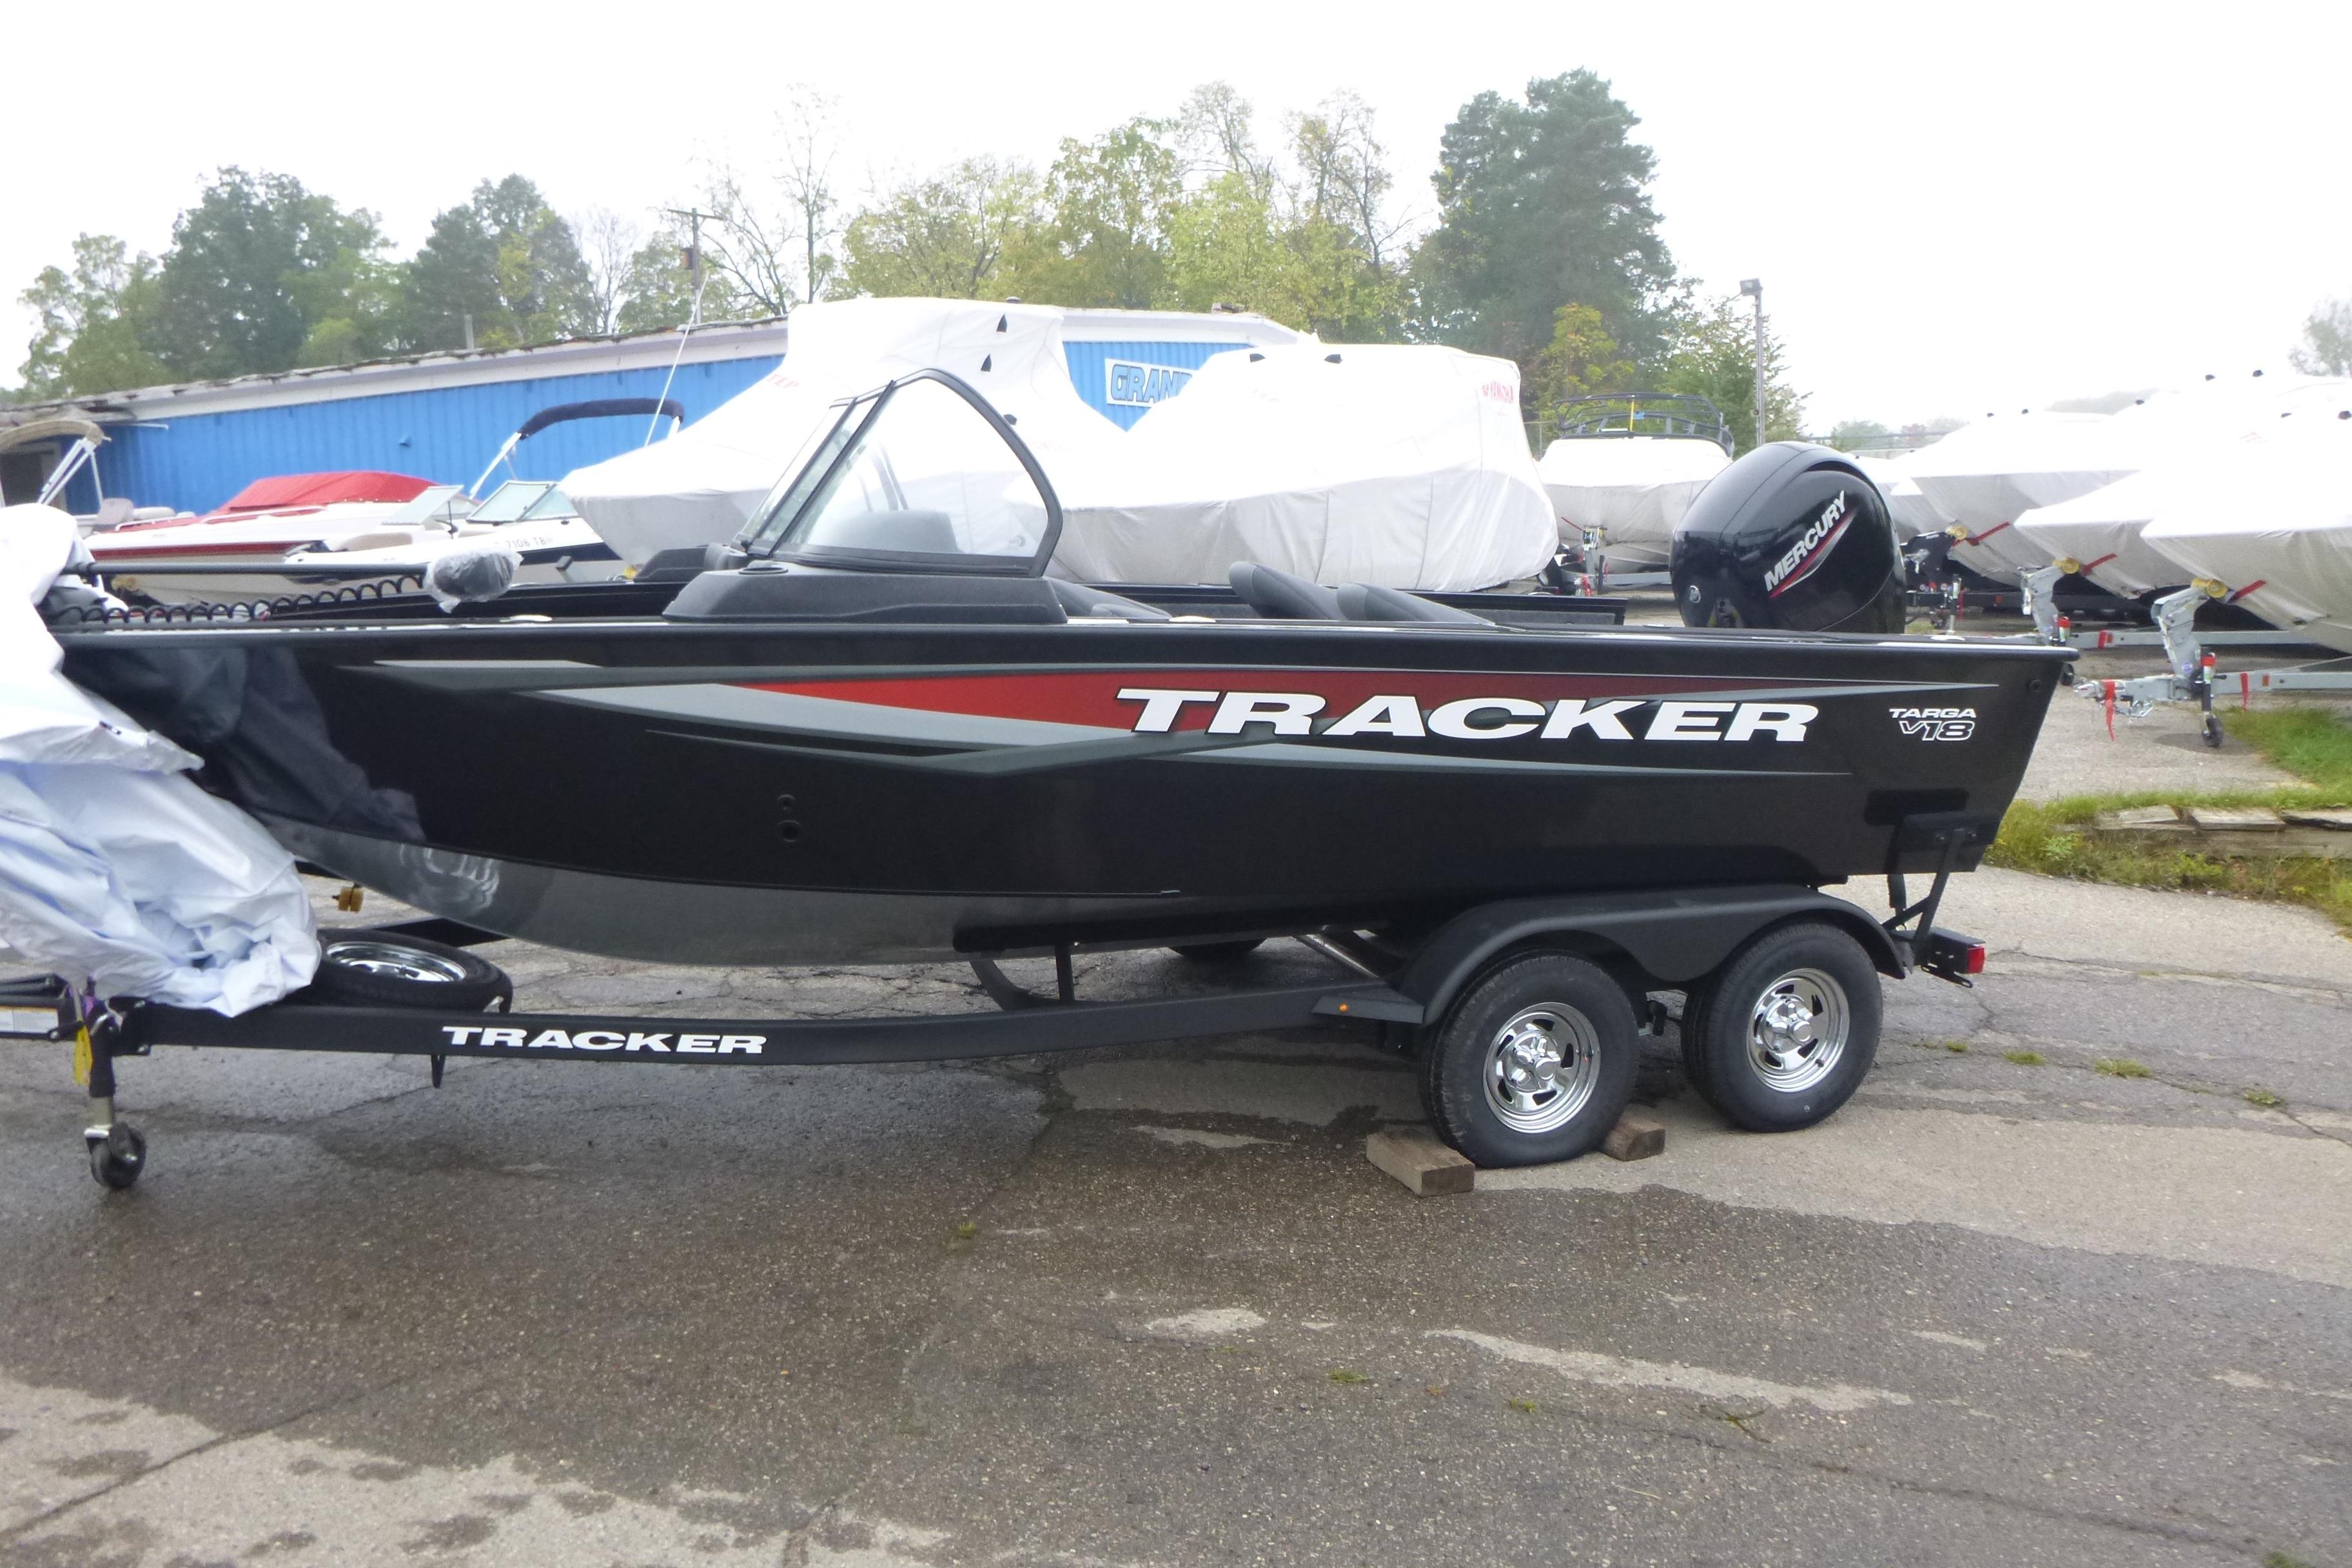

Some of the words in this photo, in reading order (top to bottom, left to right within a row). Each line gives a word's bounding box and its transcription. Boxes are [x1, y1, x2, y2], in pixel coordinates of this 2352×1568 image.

[1764, 490, 1845, 592] MERCURY
[1116, 687, 1819, 743] TRACKER
[1888, 708, 1977, 718] TARGA
[1899, 720, 1975, 741] V18
[442, 1026, 767, 1054] TRACKER
